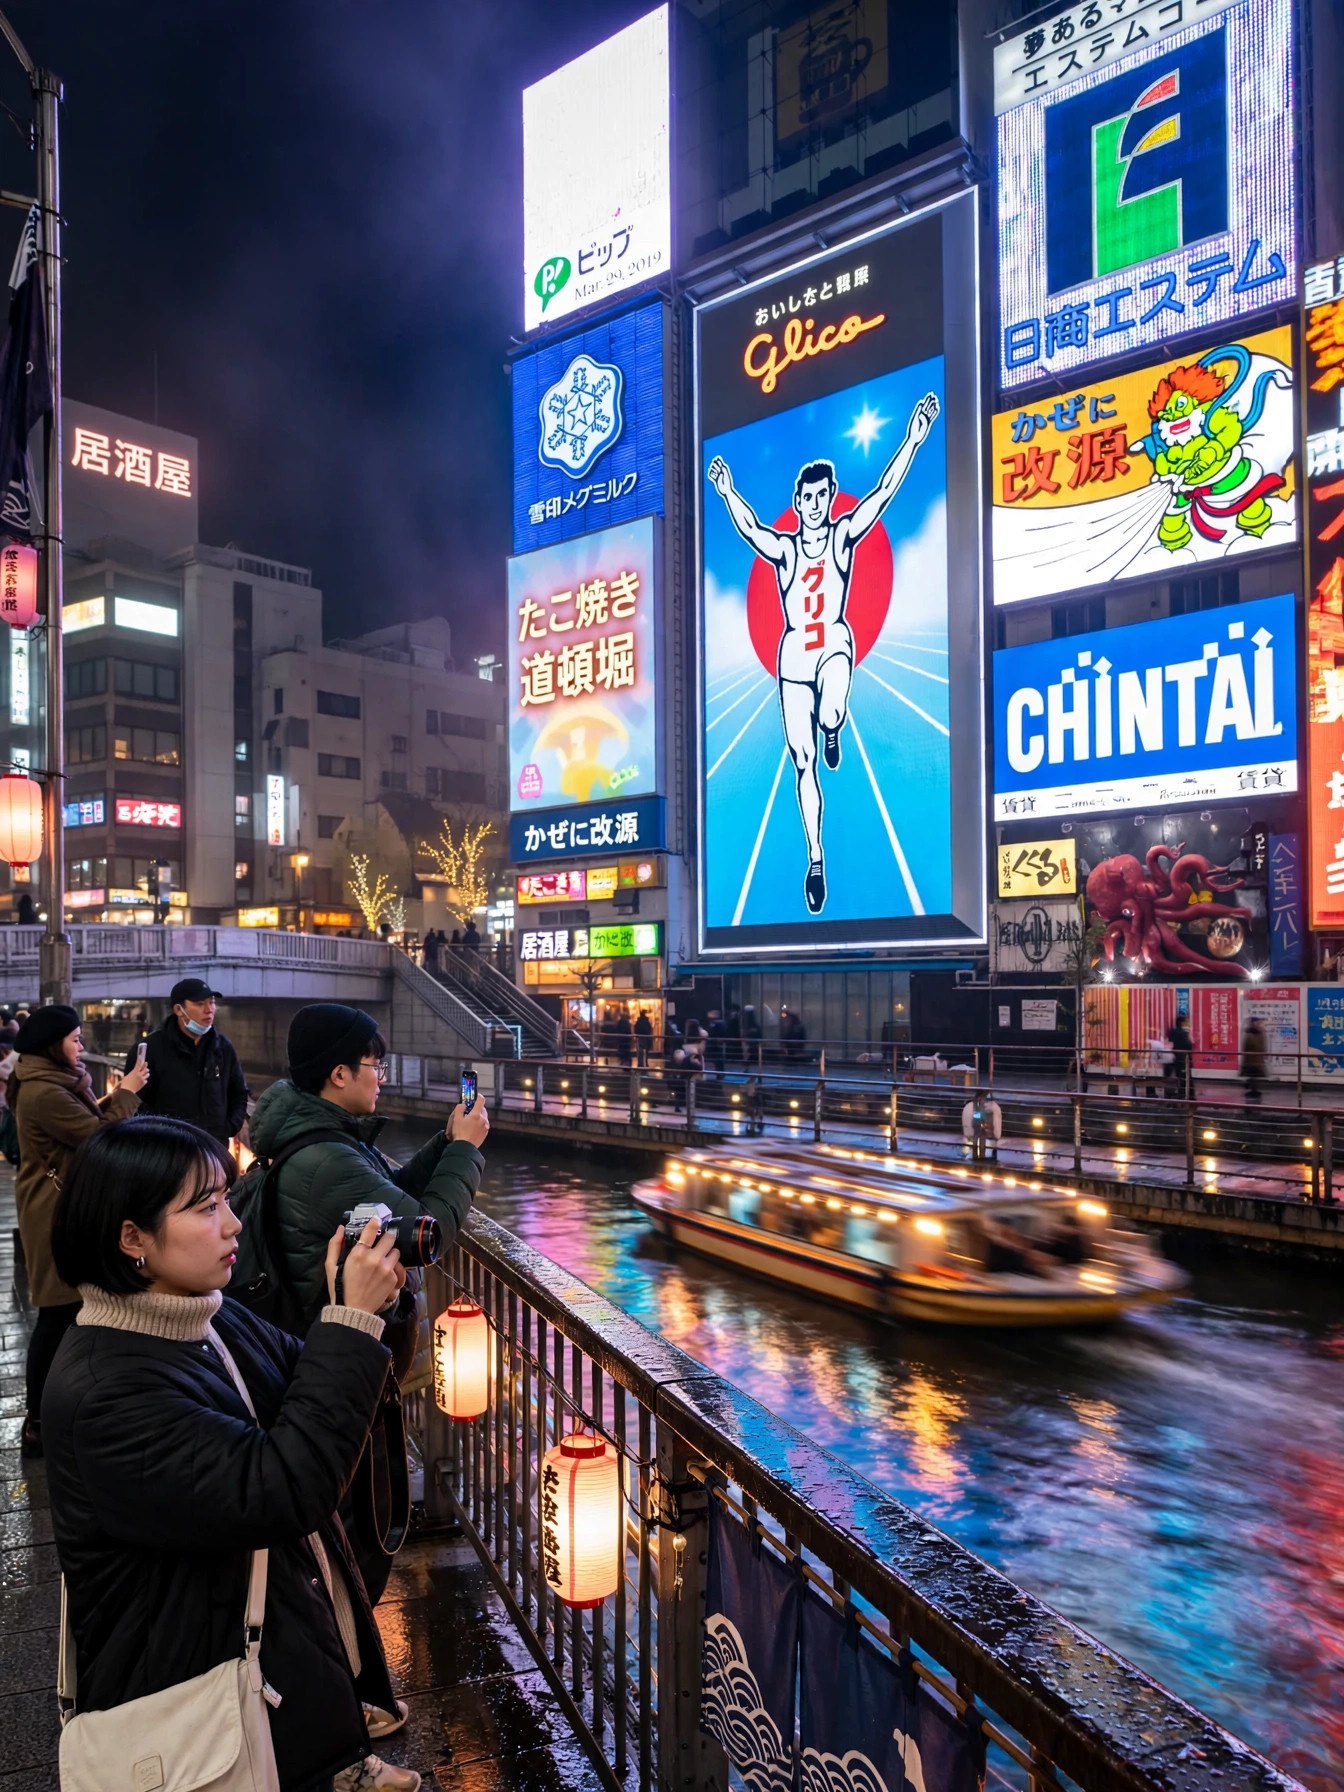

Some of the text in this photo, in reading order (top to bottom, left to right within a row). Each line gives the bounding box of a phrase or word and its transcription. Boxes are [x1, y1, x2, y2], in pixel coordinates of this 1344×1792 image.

[1024, 0, 1210, 93] エステムコ
[1004, 239, 1286, 369] 日商エステム
[1011, 394, 1117, 443] かぜに
[72, 427, 192, 497] 居酒屋
[1001, 424, 1130, 503] 改源
[528, 472, 638, 524] 雪印メグミルク
[518, 571, 640, 642] たこ焼き
[801, 560, 826, 651] グリコ
[520, 632, 635, 706] 道頓堀
[524, 811, 639, 852] かぜに改源
[520, 930, 570, 960] 居酒屋
